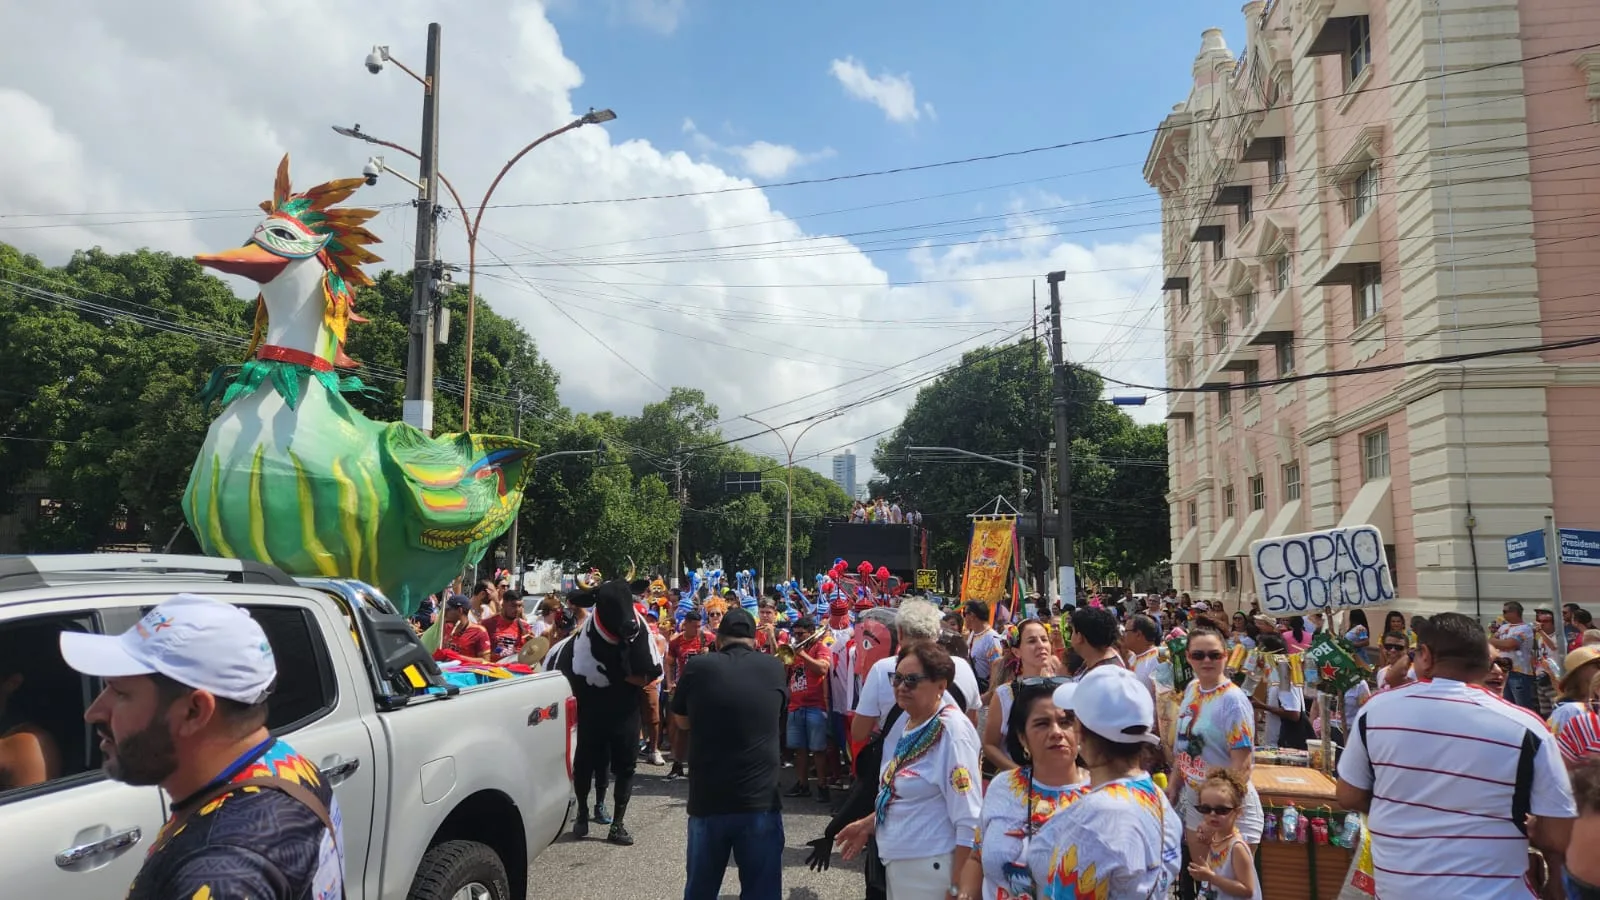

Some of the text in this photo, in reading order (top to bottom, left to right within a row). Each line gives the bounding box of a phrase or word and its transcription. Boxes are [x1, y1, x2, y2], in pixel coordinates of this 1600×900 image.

[1507, 539, 1528, 551] Marechal
[1561, 538, 1600, 550] Presidente
[1257, 529, 1380, 580] COPÃO
[1562, 547, 1589, 556] Vargas
